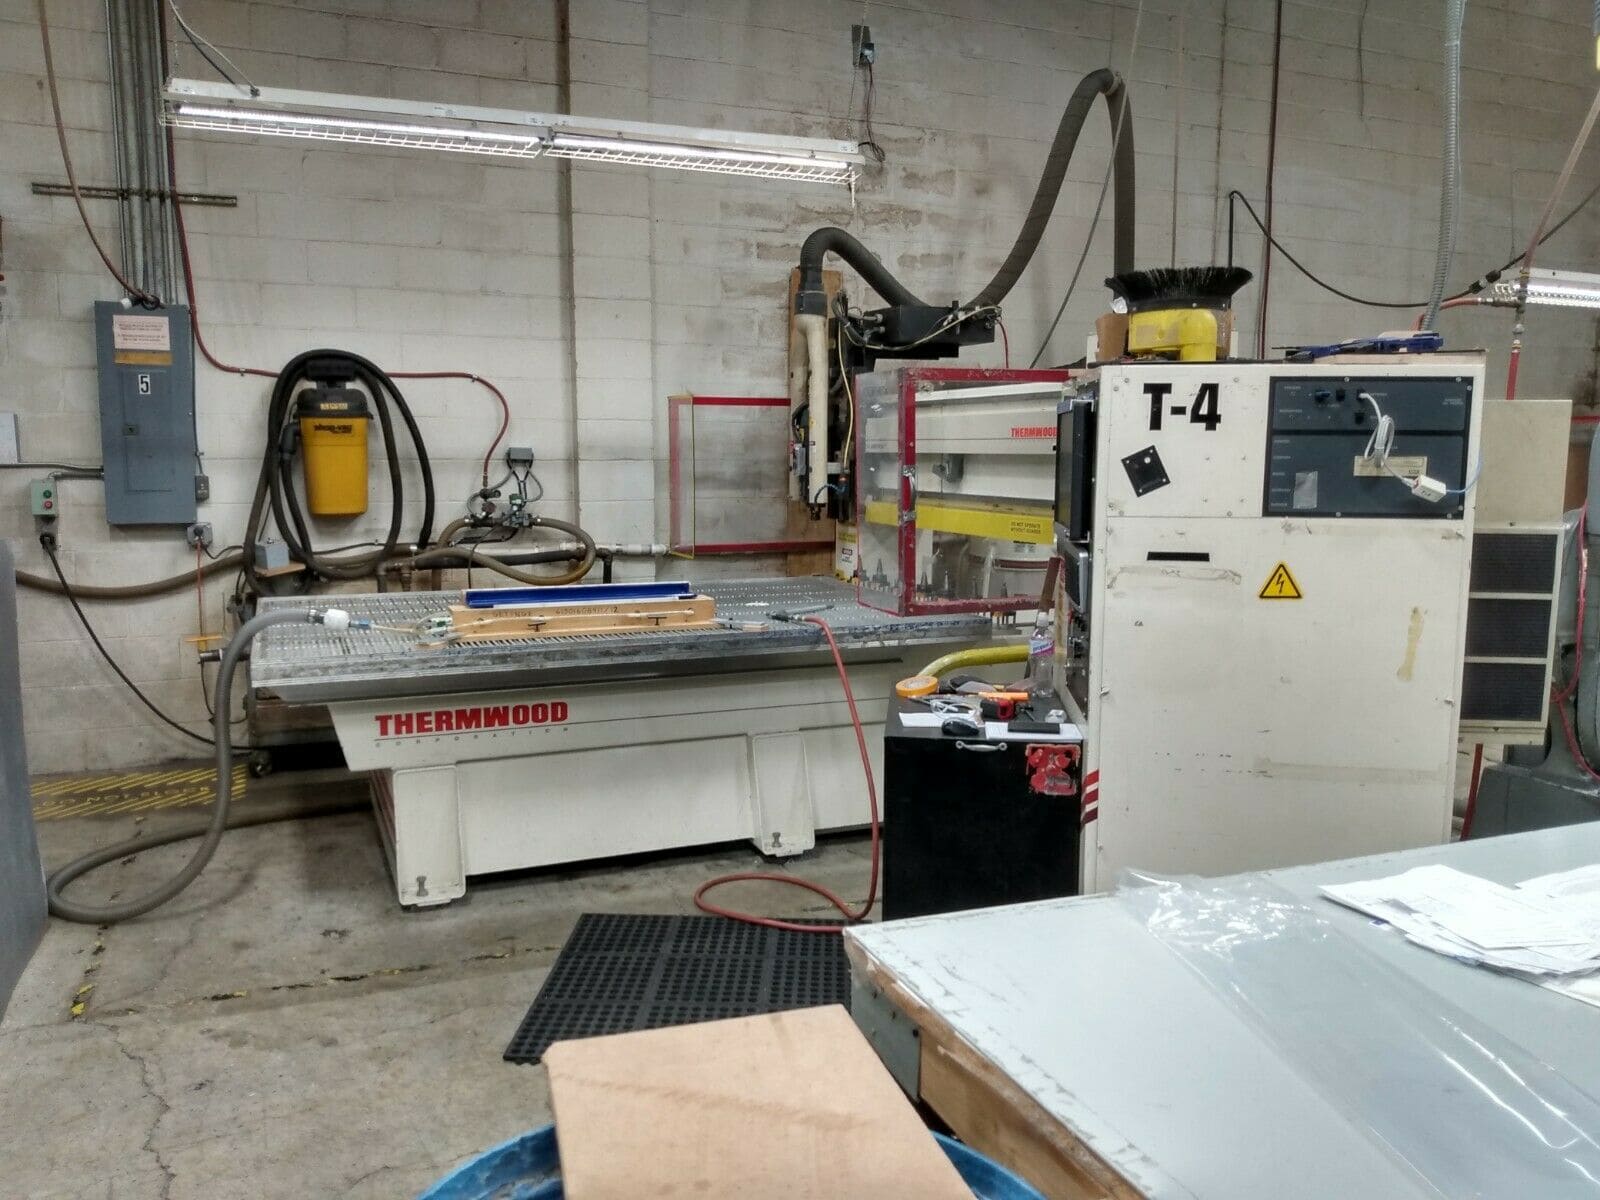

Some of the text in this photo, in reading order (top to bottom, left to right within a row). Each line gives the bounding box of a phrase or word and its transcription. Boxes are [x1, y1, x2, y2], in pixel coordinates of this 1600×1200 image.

[140, 375, 149, 393] 5
[1143, 383, 1221, 431] T-4
[375, 702, 568, 736] THERMWOOD
[375, 727, 569, 748] CORPORATION
